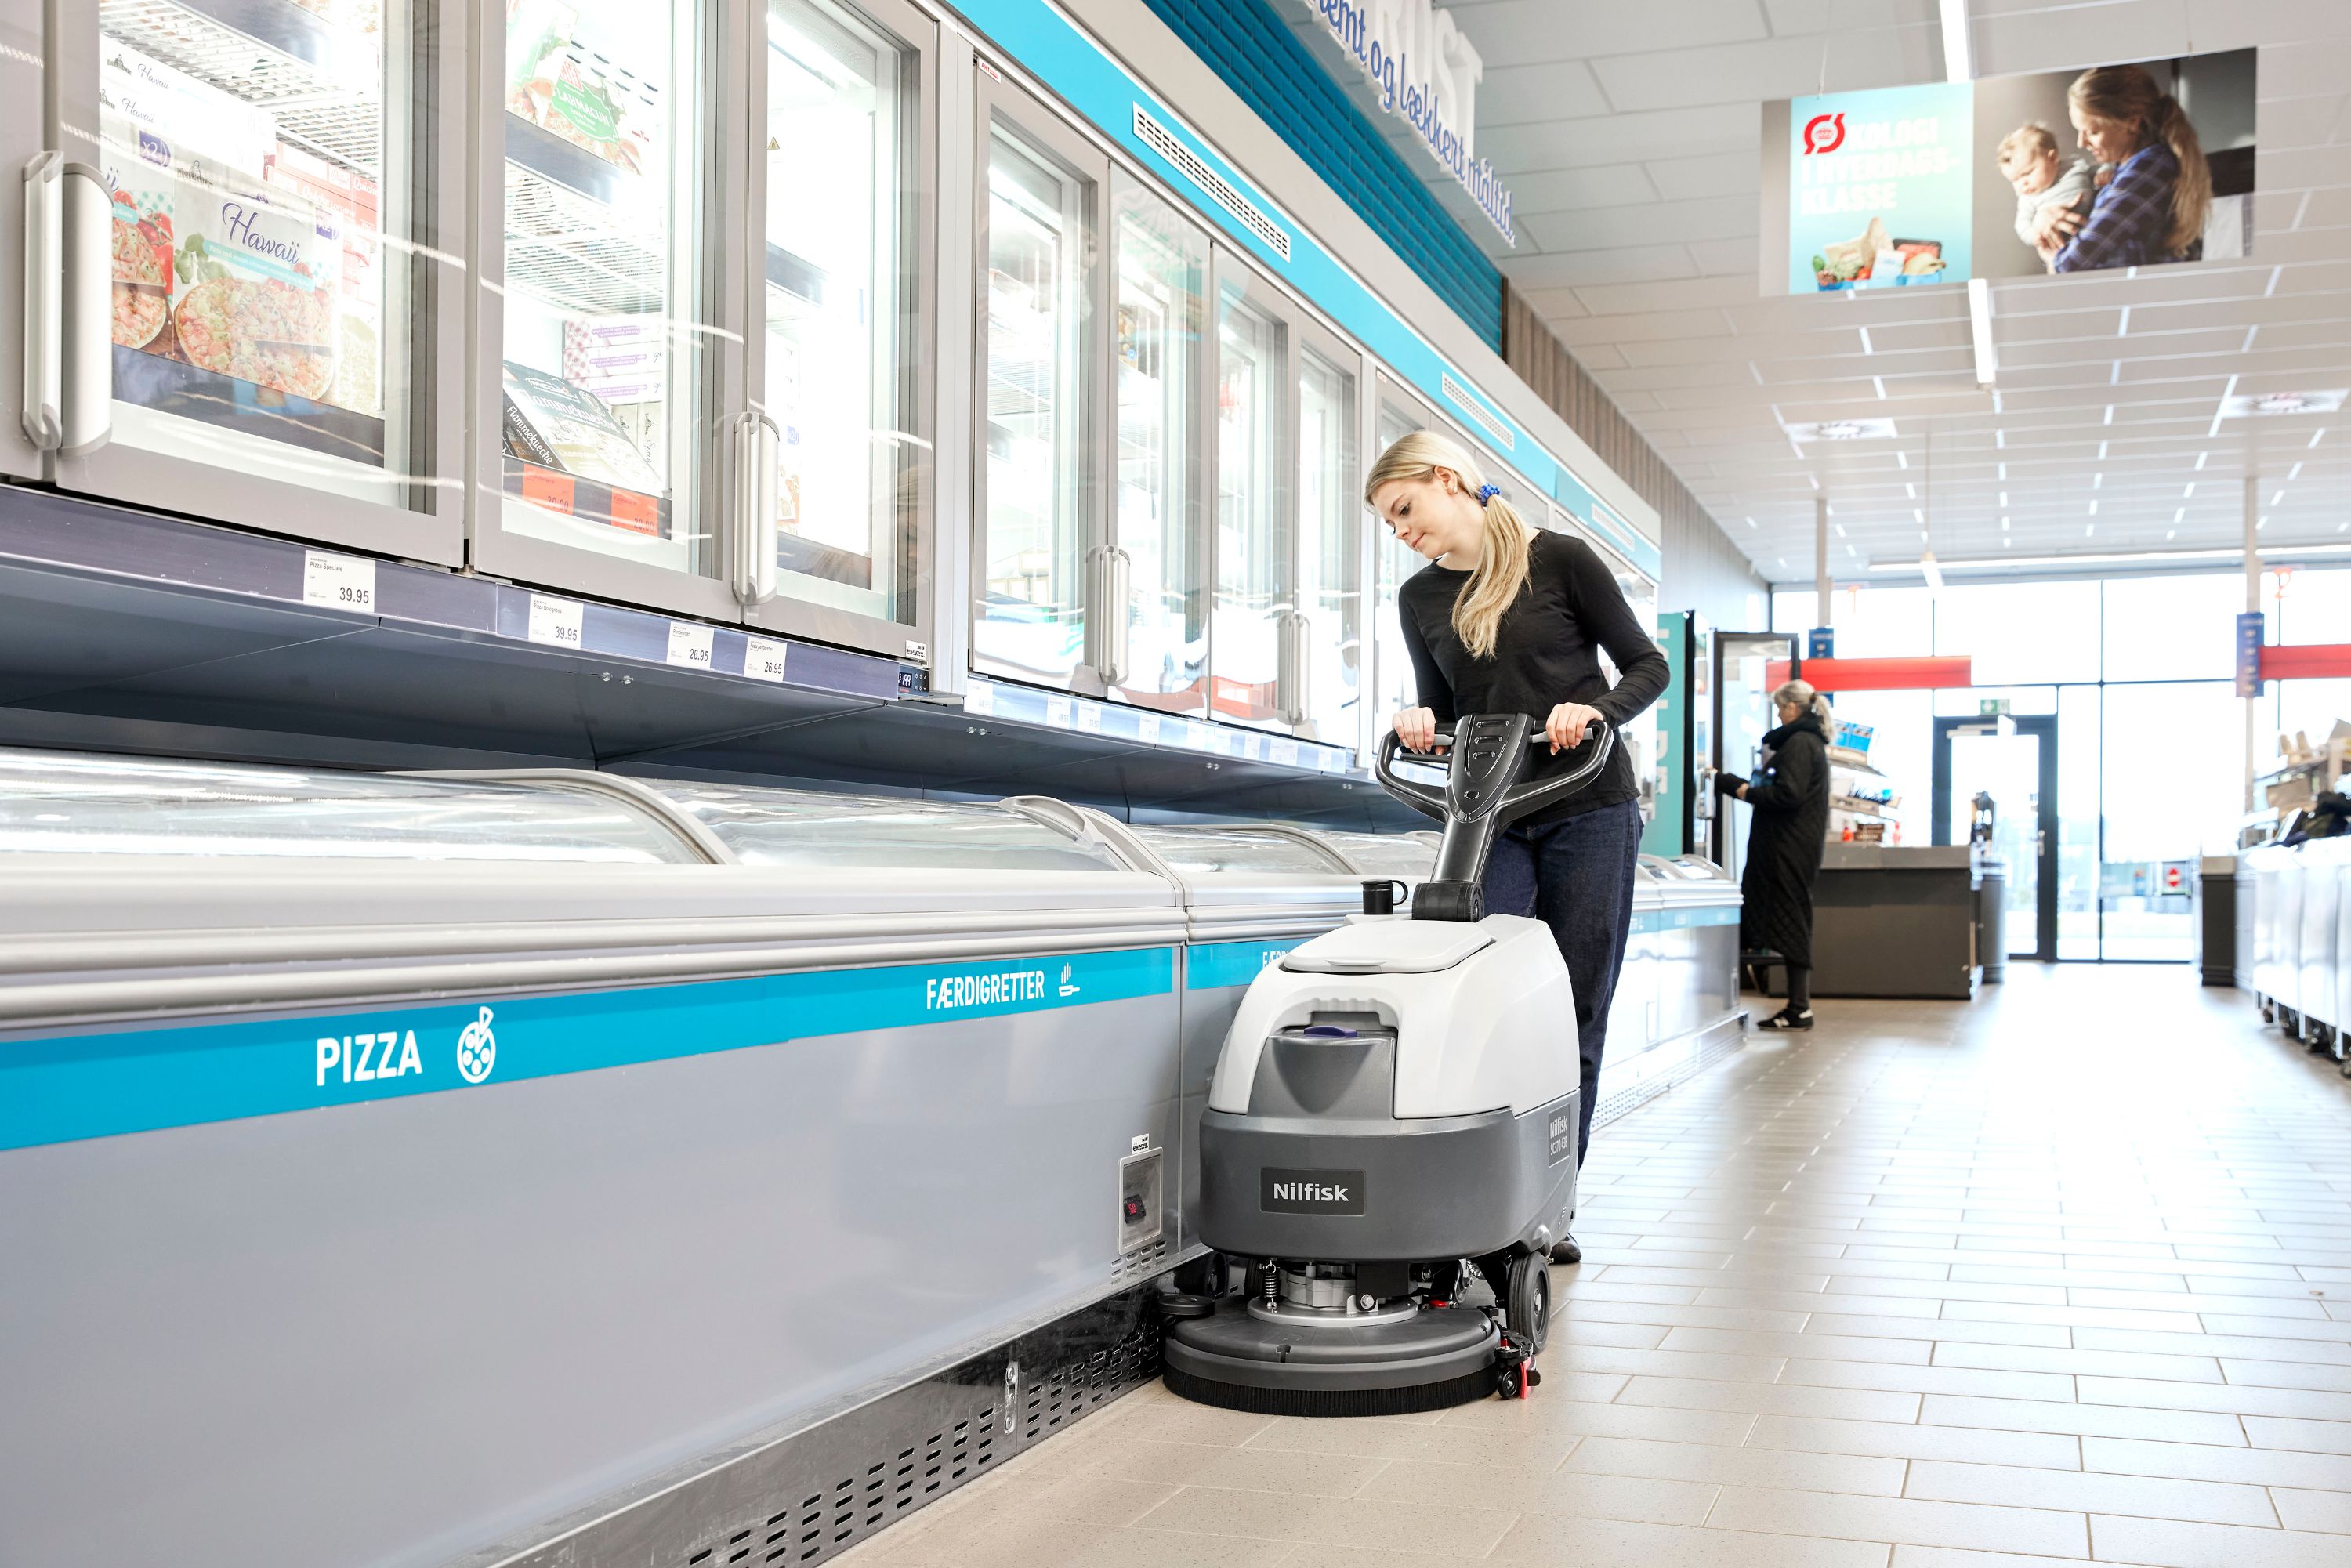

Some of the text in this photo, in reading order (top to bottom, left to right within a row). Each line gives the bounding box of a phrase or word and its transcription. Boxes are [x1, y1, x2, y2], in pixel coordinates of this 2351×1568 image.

[138, 63, 169, 89] Hawaii
[121, 97, 155, 124] Hawaii
[1370, 39, 1395, 111] og
[1400, 52, 1465, 181] lækkert
[222, 202, 300, 265] Hawaii
[506, 405, 553, 464] Flammekueche
[323, 563, 342, 572] Speciale
[339, 586, 369, 603] 39.95
[555, 625, 578, 641] 39.95
[689, 648, 708, 661] 26.95
[764, 661, 782, 674] 26.95
[926, 970, 1045, 1010] FÆRDIGRETTER
[316, 1029, 423, 1087] PIZZA
[1550, 1115, 1568, 1139] Nilfisk
[1273, 1182, 1349, 1202] Nilfisk
